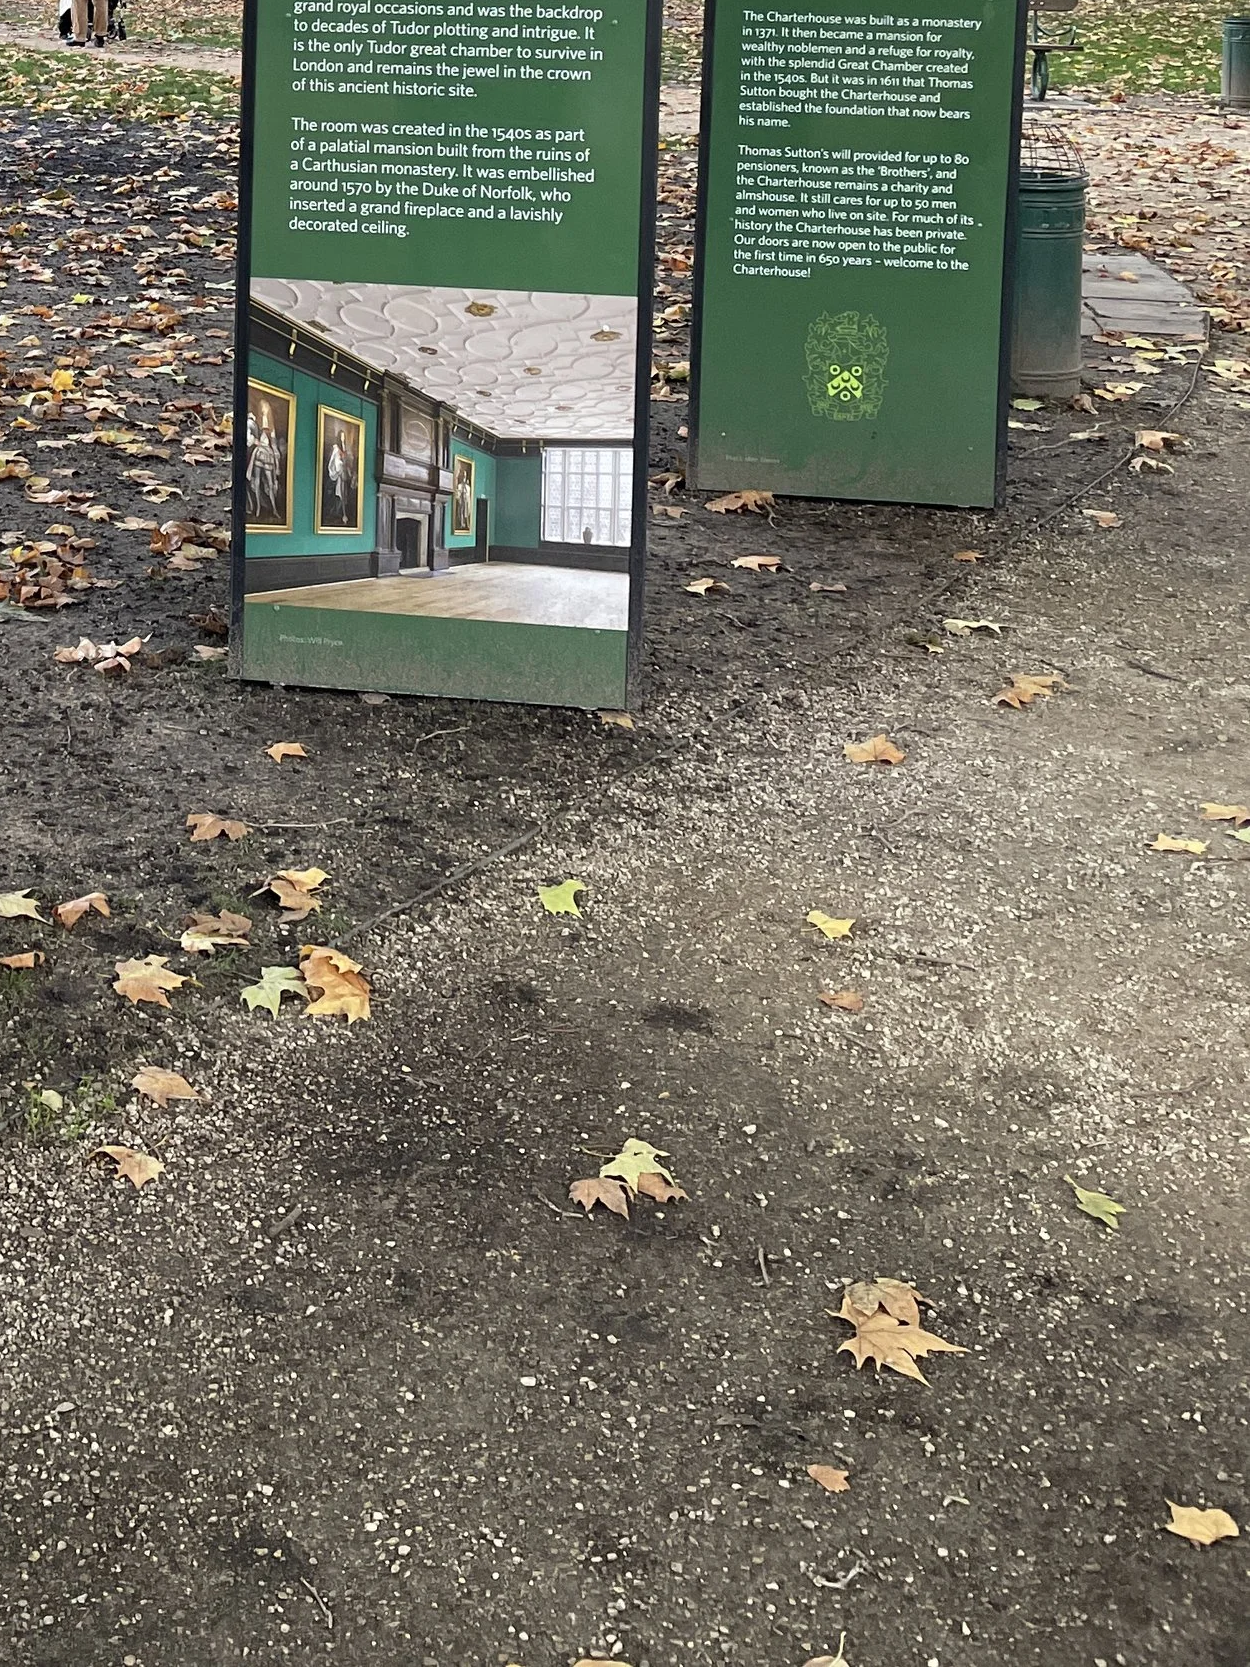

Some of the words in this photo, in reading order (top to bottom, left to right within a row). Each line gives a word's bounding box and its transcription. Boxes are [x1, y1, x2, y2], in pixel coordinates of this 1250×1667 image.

[336, 0, 371, 16] royal
[374, 1, 445, 16] occasions
[446, 2, 474, 17] and
[476, 6, 506, 18] was
[508, 3, 533, 19] the
[535, 3, 603, 23] backdrop
[742, 9, 765, 22] The
[766, 10, 843, 25] Charterhouse
[843, 16, 868, 26] was
[868, 13, 895, 26] built
[896, 17, 910, 27] as
[911, 18, 920, 27] a
[921, 18, 983, 31] monastery
[293, 18, 309, 32] to
[310, 17, 370, 34] decades
[371, 19, 387, 34] of
[389, 20, 431, 36] Tudor
[433, 21, 489, 40] plotting
[491, 23, 519, 38] and
[521, 24, 581, 43] intrigue.
[584, 25, 596, 41] It
[742, 25, 753, 37] in
[781, 26, 790, 38] It
[791, 26, 818, 39] then
[819, 27, 865, 41] became
[865, 31, 874, 41] a
[875, 32, 924, 42] mansion
[926, 30, 943, 43] for
[741, 40, 786, 55] wealthy
[787, 41, 843, 55] noblemen
[844, 43, 867, 56] and
[867, 46, 876, 56] a
[877, 44, 914, 59] refuge
[915, 45, 933, 58] for
[933, 47, 975, 61] royalty,
[740, 55, 766, 67] with
[767, 55, 787, 68] the
[788, 56, 836, 70] splendid
[837, 58, 870, 71] Great
[871, 59, 924, 73] Chamber
[925, 62, 969, 74] created
[290, 116, 318, 132] The
[320, 121, 358, 133] room
[360, 123, 390, 135] was
[391, 122, 446, 137] created
[448, 123, 462, 137] in
[464, 123, 489, 139] the
[490, 127, 533, 143] 1540s
[534, 129, 552, 141] as
[554, 128, 586, 144] part
[290, 136, 306, 151] of
[307, 140, 317, 152] a
[319, 138, 370, 155] palatial
[373, 141, 434, 156] mansion
[436, 142, 469, 158] built
[471, 143, 506, 159] from
[508, 145, 533, 160] the
[535, 146, 572, 162] ruins
[574, 147, 591, 163] of
[737, 144, 783, 158] Thomas
[784, 146, 830, 160] Sutton's
[831, 148, 852, 160] will
[852, 150, 903, 163] provided
[904, 150, 922, 163] for
[922, 154, 938, 166] up
[939, 153, 953, 165] to
[953, 153, 970, 165] 80
[736, 160, 800, 174] pensioners,
[801, 161, 839, 175] known
[840, 166, 855, 176] as
[856, 164, 876, 176] the
[935, 168, 957, 180] and
